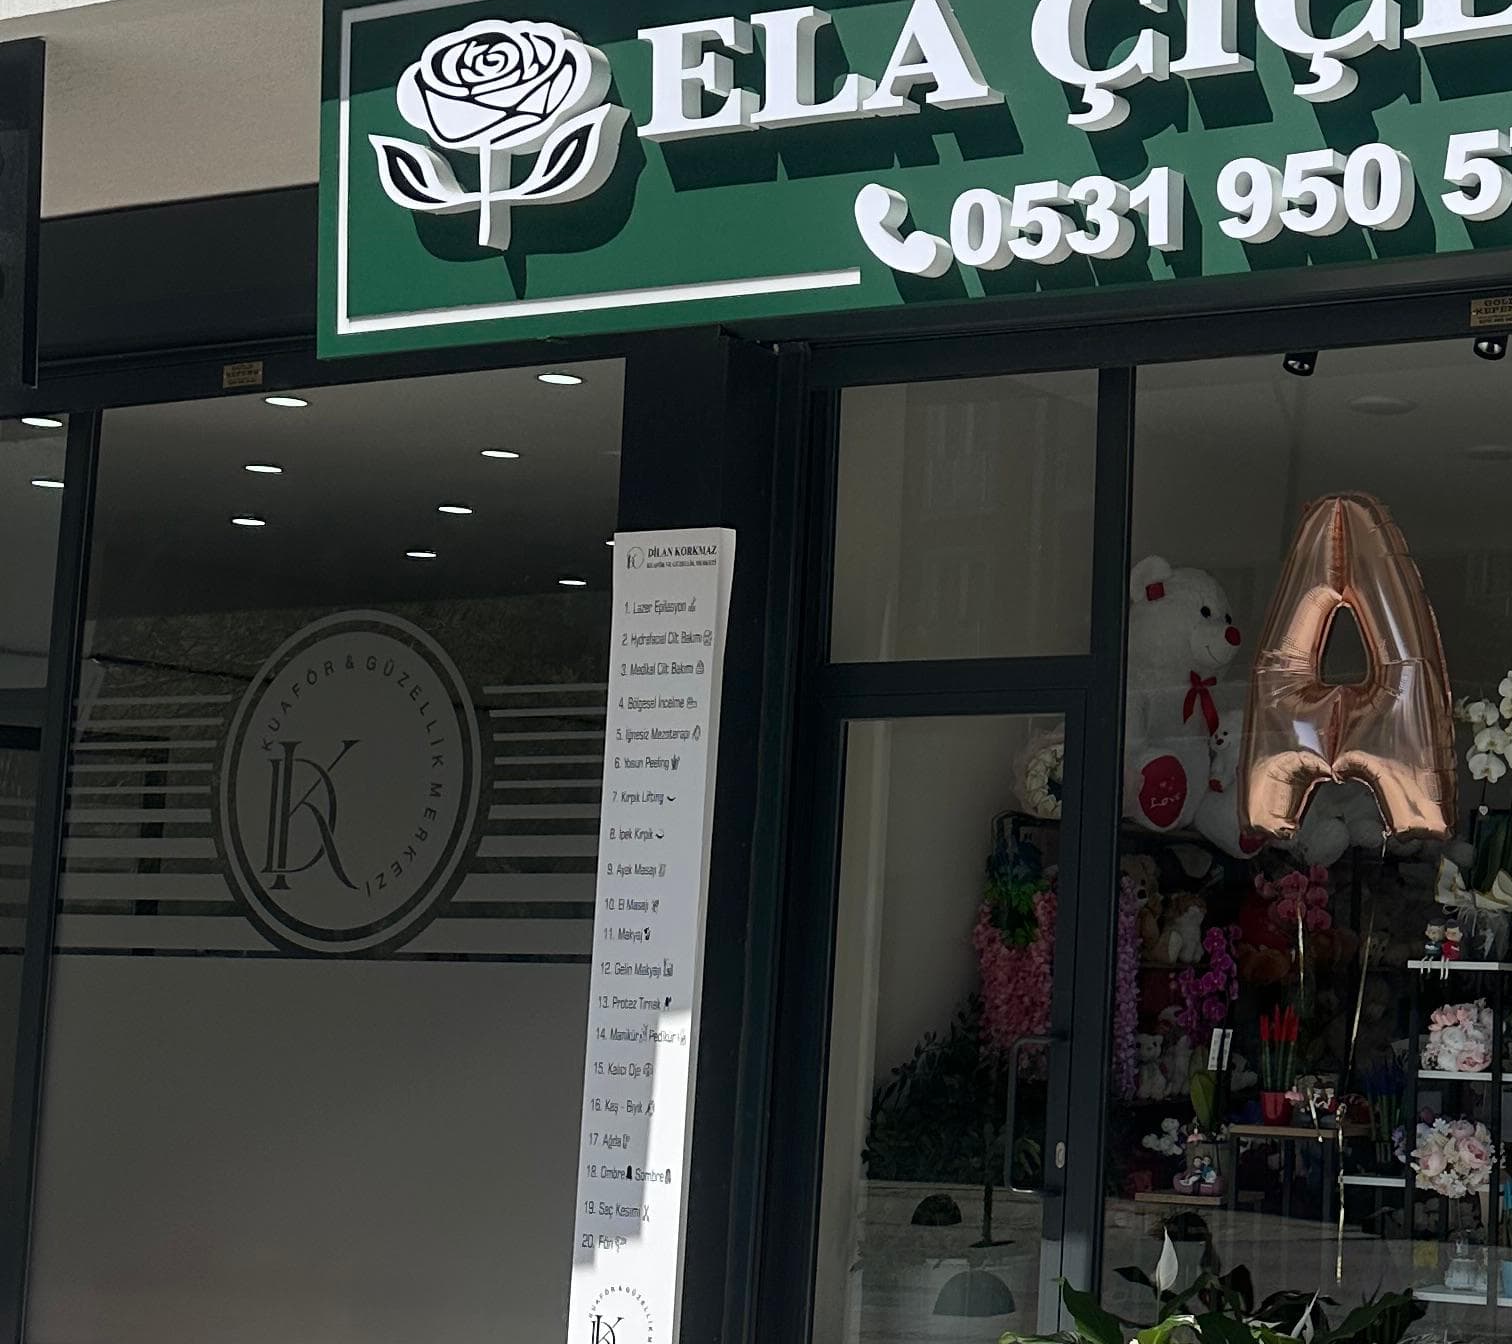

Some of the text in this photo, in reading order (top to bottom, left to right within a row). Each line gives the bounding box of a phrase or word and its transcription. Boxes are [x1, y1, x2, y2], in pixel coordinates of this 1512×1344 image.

[950, 166, 1184, 270] 0531
[1216, 142, 1415, 244] 950
[675, 545, 717, 557] KORKMAZ
